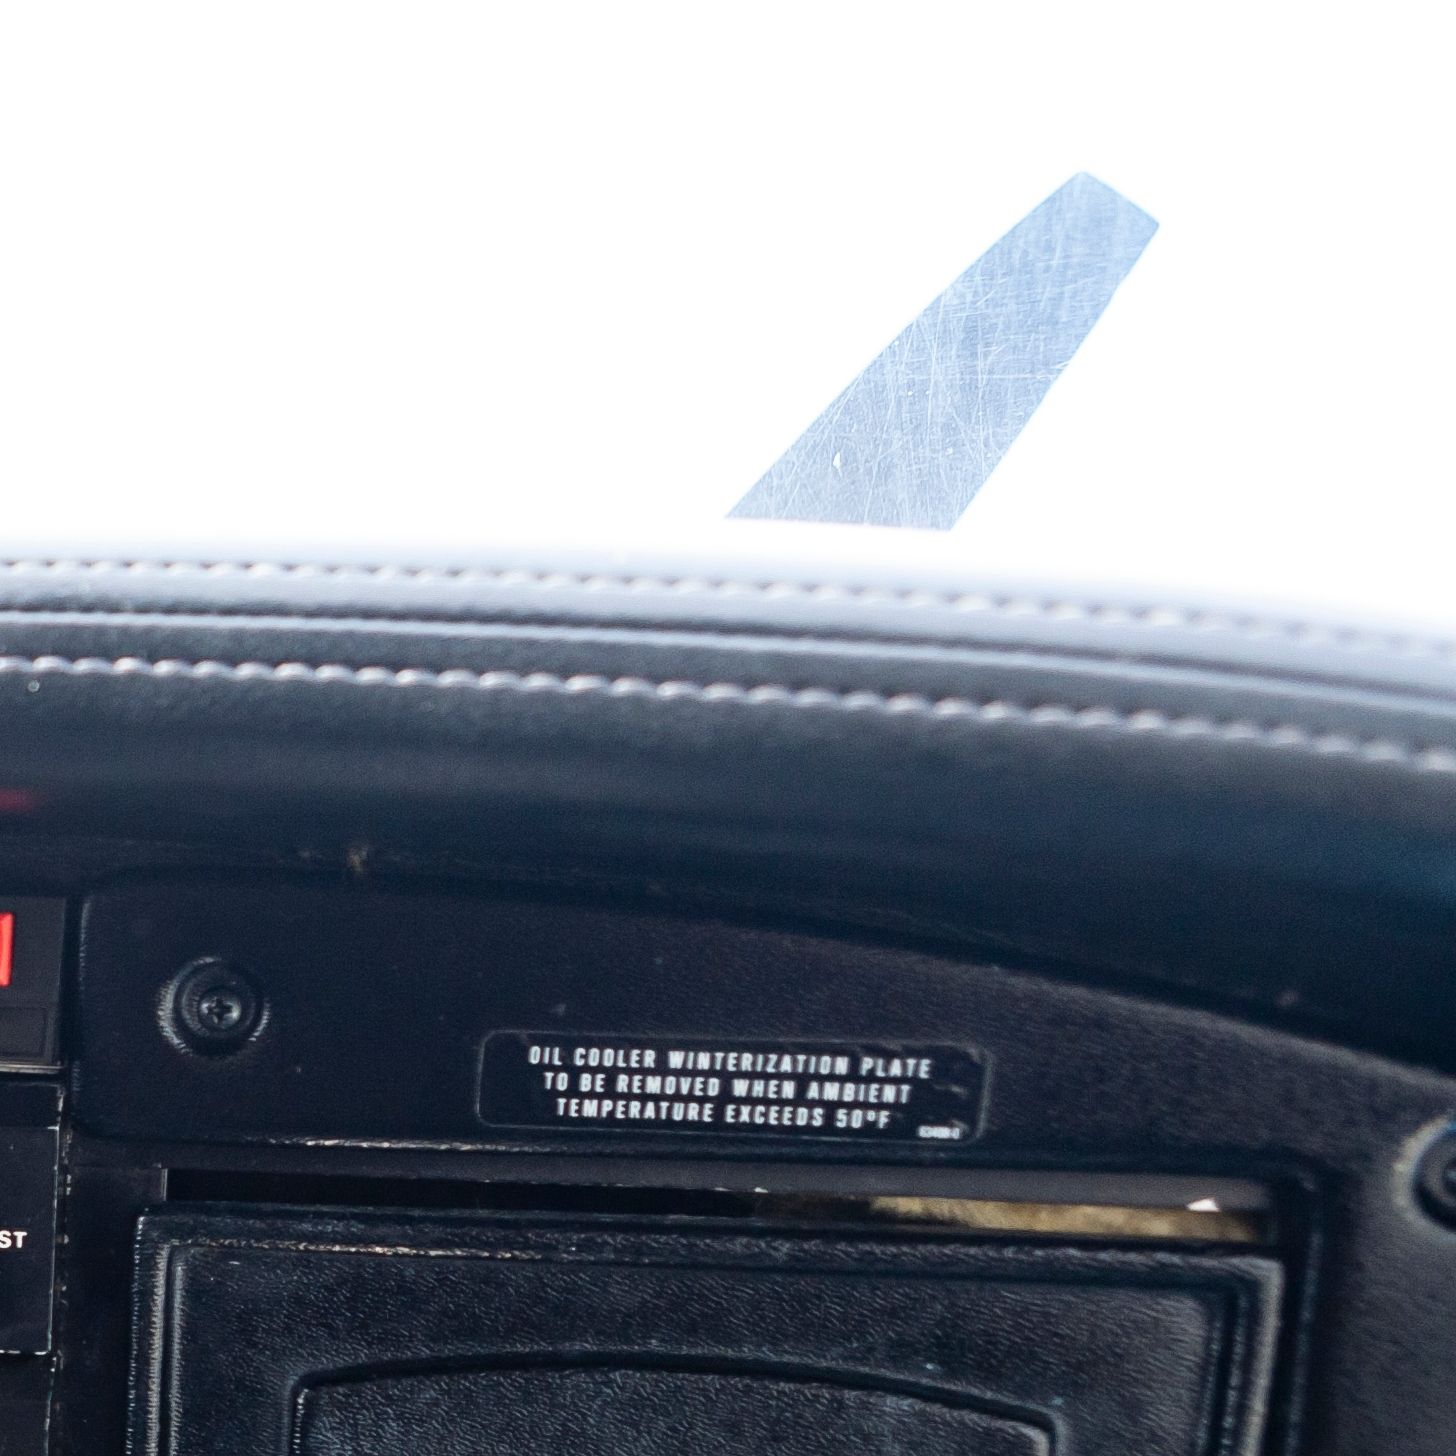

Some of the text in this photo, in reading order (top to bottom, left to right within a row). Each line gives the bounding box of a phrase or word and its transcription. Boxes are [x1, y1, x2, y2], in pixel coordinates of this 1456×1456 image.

[528, 1045, 932, 1080] OIL COOLER WINTERIZATION PLATE
[544, 1071, 912, 1105] TO BE REMOVED WHEN AMBIENT
[556, 1098, 826, 1128] TEMPERATURE EXCEEDS
